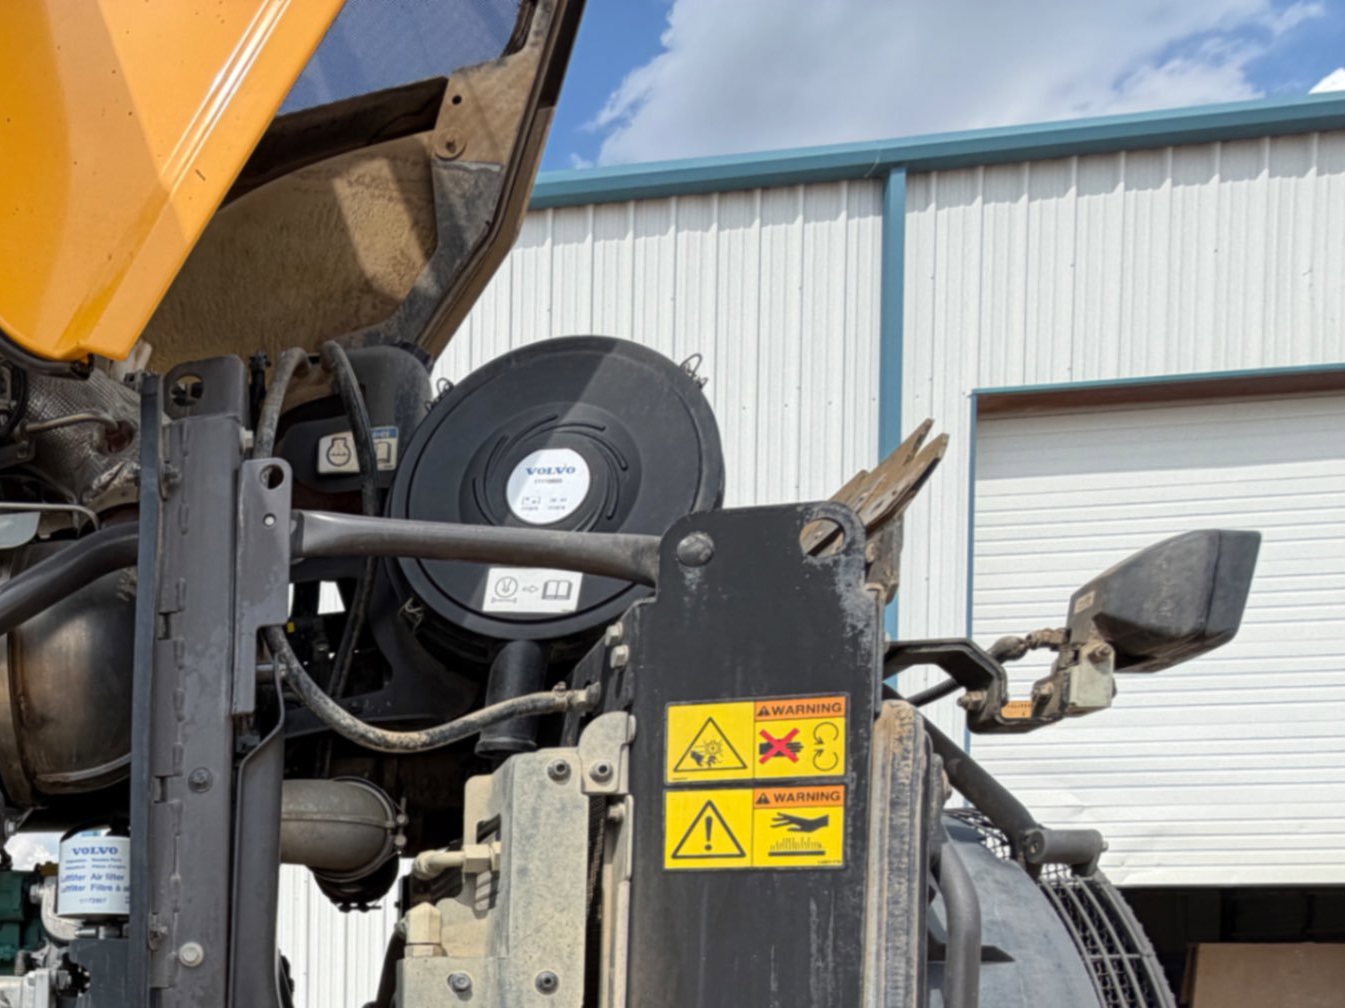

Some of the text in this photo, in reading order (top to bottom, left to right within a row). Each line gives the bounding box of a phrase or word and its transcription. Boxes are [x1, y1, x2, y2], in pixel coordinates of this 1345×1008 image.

[525, 465, 576, 476] VOLVO
[771, 702, 842, 716] WARNING
[773, 790, 841, 804] WARNING
[72, 846, 119, 855] VOLVO
[91, 873, 103, 881] Air
[105, 873, 125, 881] filter
[91, 884, 113, 892] Filtre
